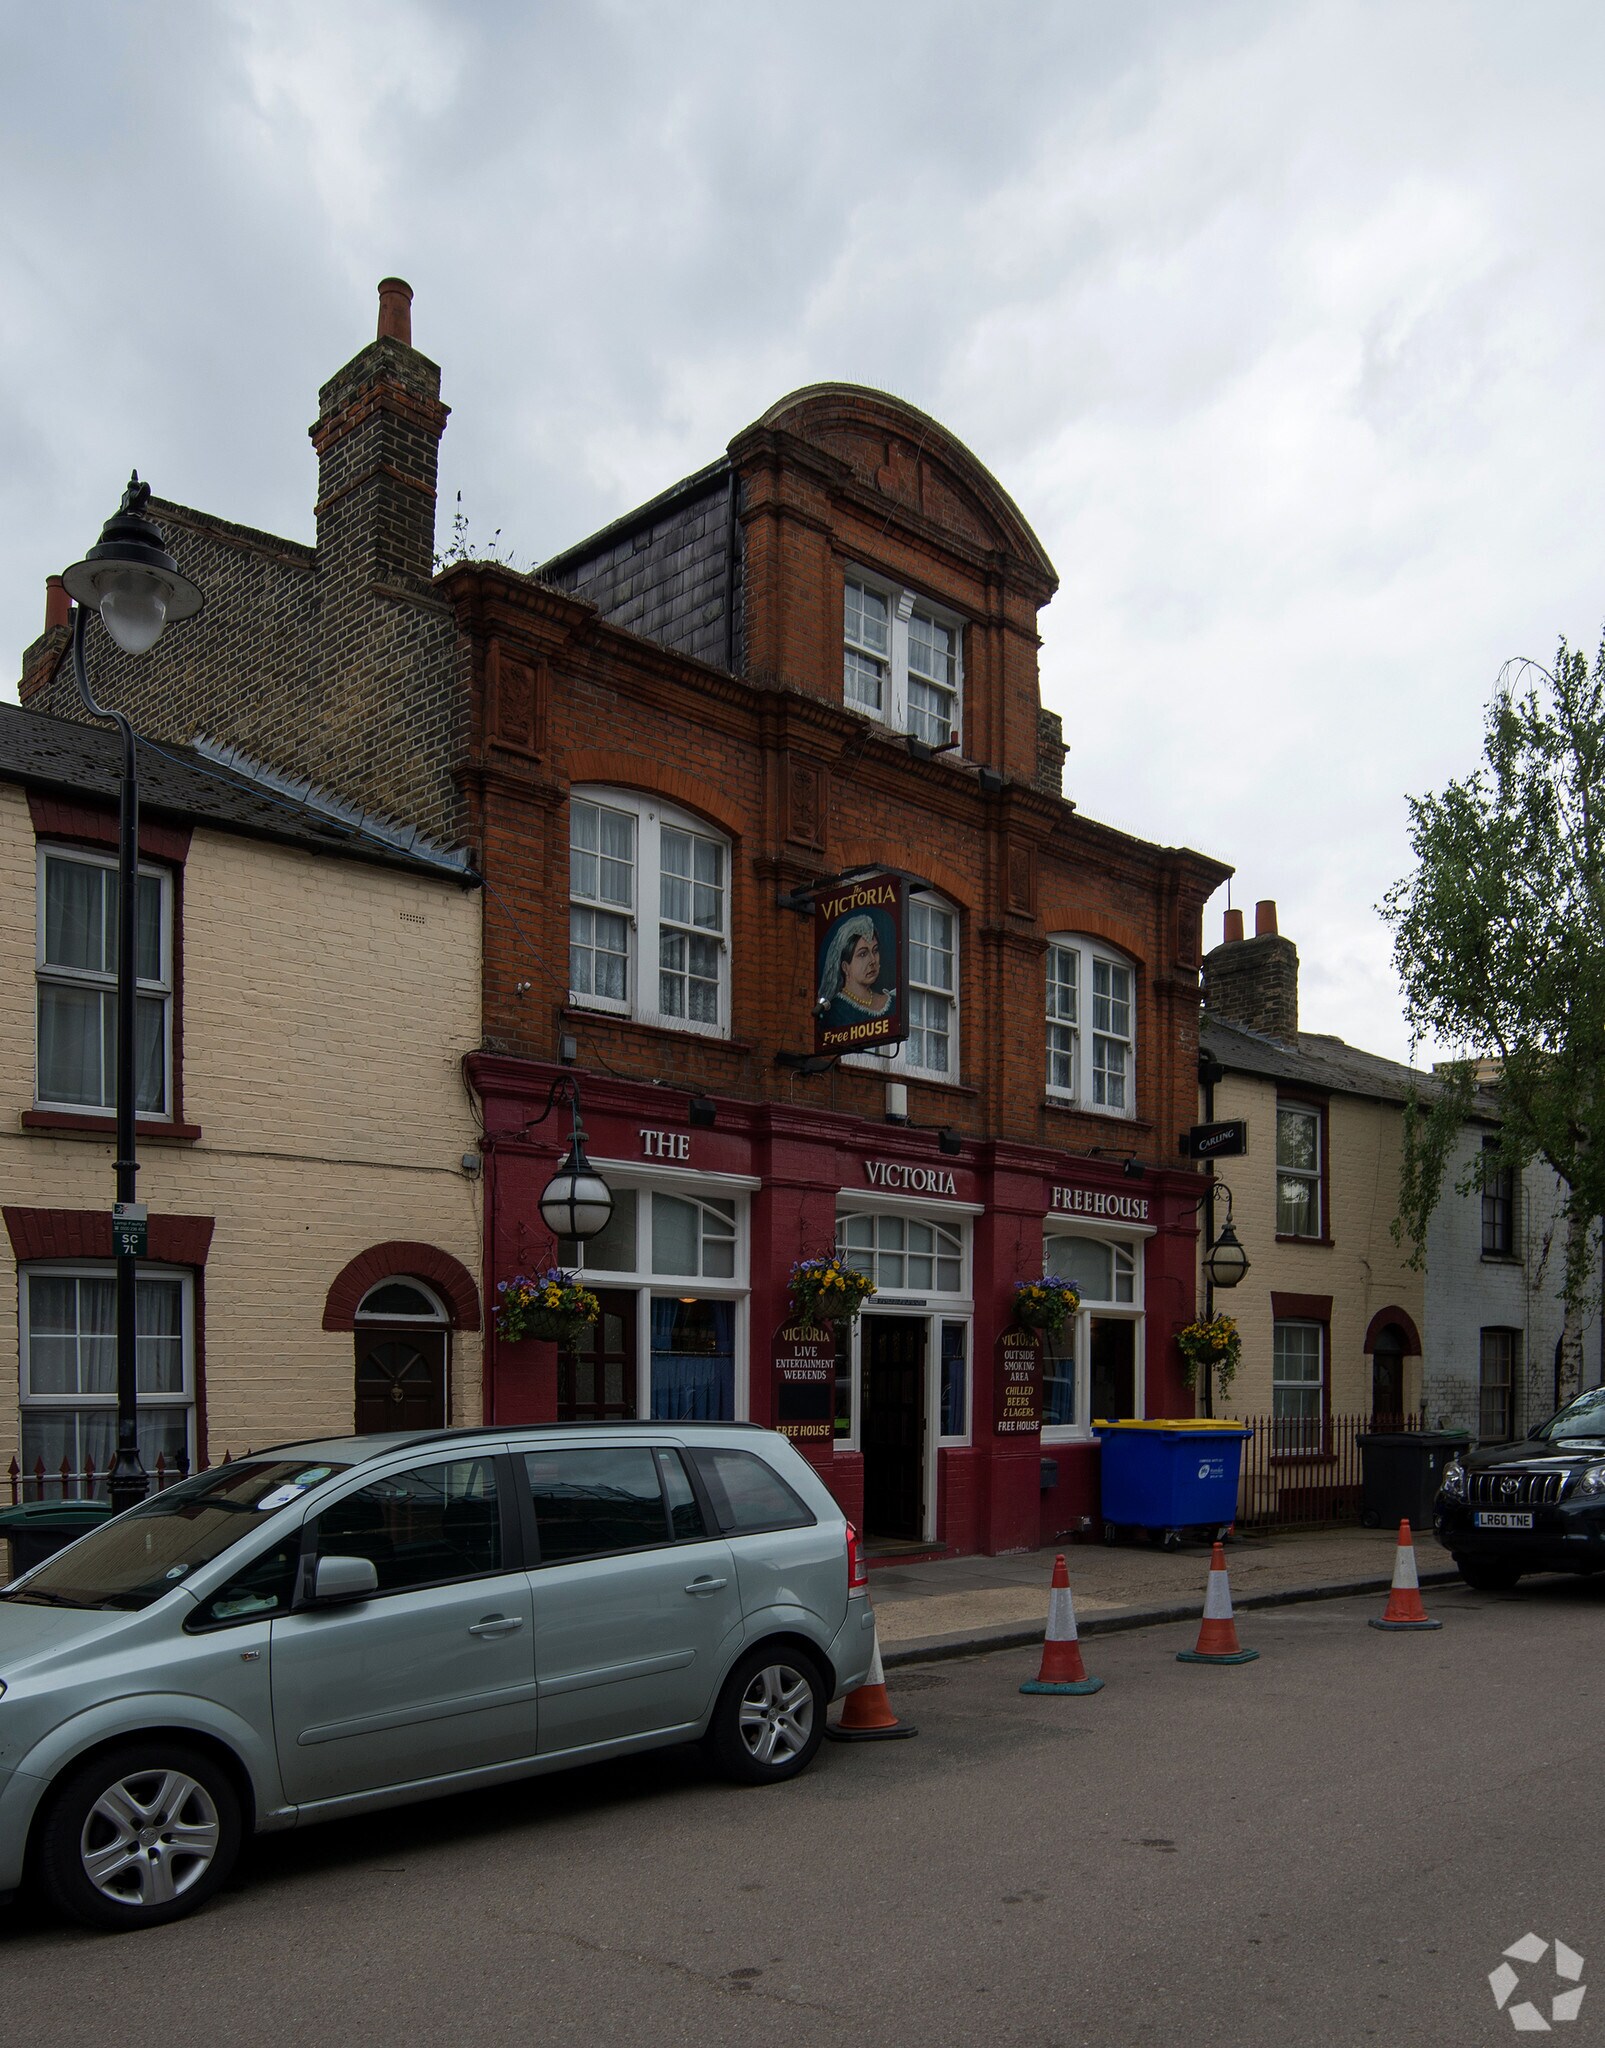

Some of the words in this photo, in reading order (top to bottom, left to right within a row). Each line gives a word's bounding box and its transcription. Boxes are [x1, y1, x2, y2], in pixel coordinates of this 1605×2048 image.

[821, 884, 896, 920] VICTORIA
[850, 1019, 889, 1041] HOUSE
[639, 1129, 690, 1160] THE
[864, 1160, 957, 1195] VICTORIA
[1051, 1186, 1149, 1220] FREEHOUSE
[121, 1234, 139, 1244] SC
[123, 1245, 137, 1254] 7L
[782, 1326, 830, 1342] VICTORIA
[1001, 1332, 1040, 1347] VICTOA
[794, 1346, 818, 1357] LIVE
[1004, 1350, 1035, 1360] OUTSIDE
[775, 1358, 835, 1369] ENTERTAINMENT
[1004, 1361, 1035, 1371] SMOKING
[784, 1369, 827, 1380] WEEKENDS
[1010, 1372, 1029, 1382] AREA
[1005, 1386, 1034, 1396] CHILLED
[1007, 1397, 1029, 1406] BEERS
[1009, 1407, 1035, 1417] LAGERS
[800, 1425, 831, 1436] HOUSE
[998, 1421, 1016, 1432] FREE
[1016, 1420, 1040, 1431] HOUSE
[1481, 1514, 1507, 1526] LR60
[1510, 1514, 1530, 1526] TNE
